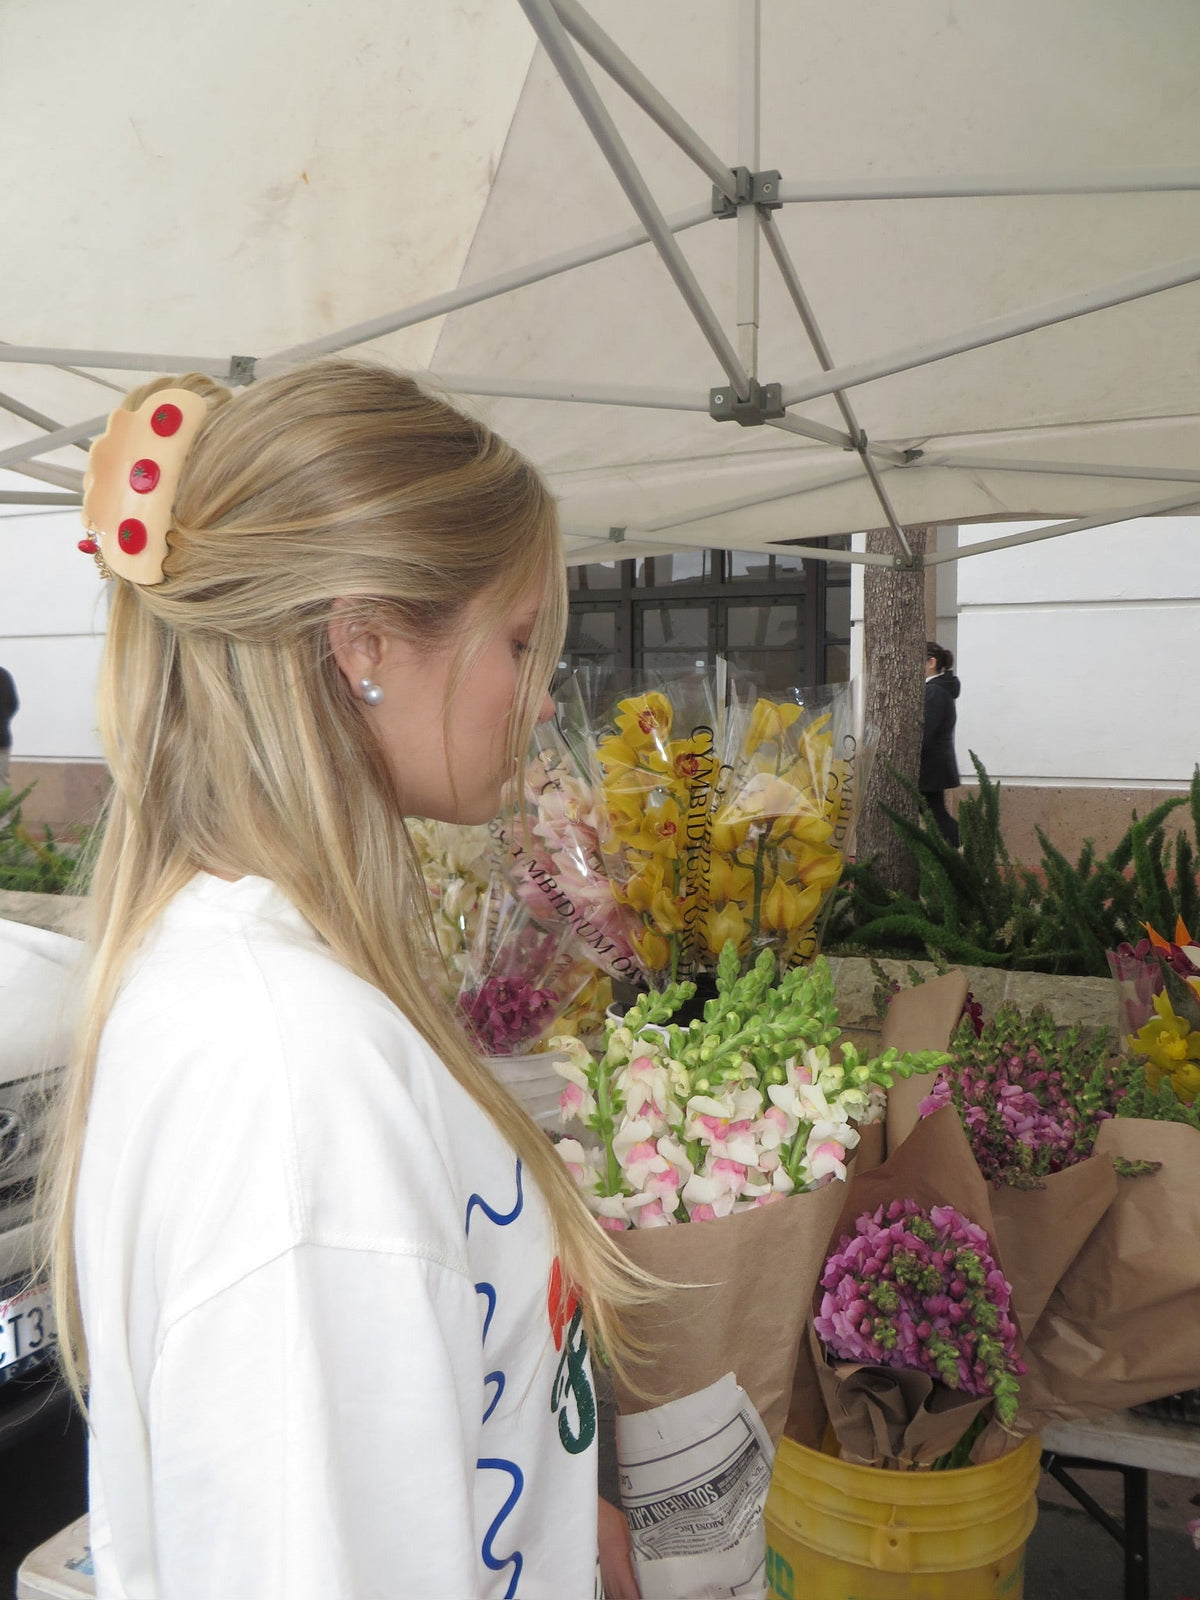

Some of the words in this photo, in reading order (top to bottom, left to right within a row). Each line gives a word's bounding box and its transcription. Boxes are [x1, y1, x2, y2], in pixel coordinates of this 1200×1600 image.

[685, 724, 715, 899] CYMBIDIUM
[833, 734, 857, 851] CYMBIDI
[512, 845, 616, 956] YMBIDIUM
[651, 1483, 719, 1522] SOUTHERN
